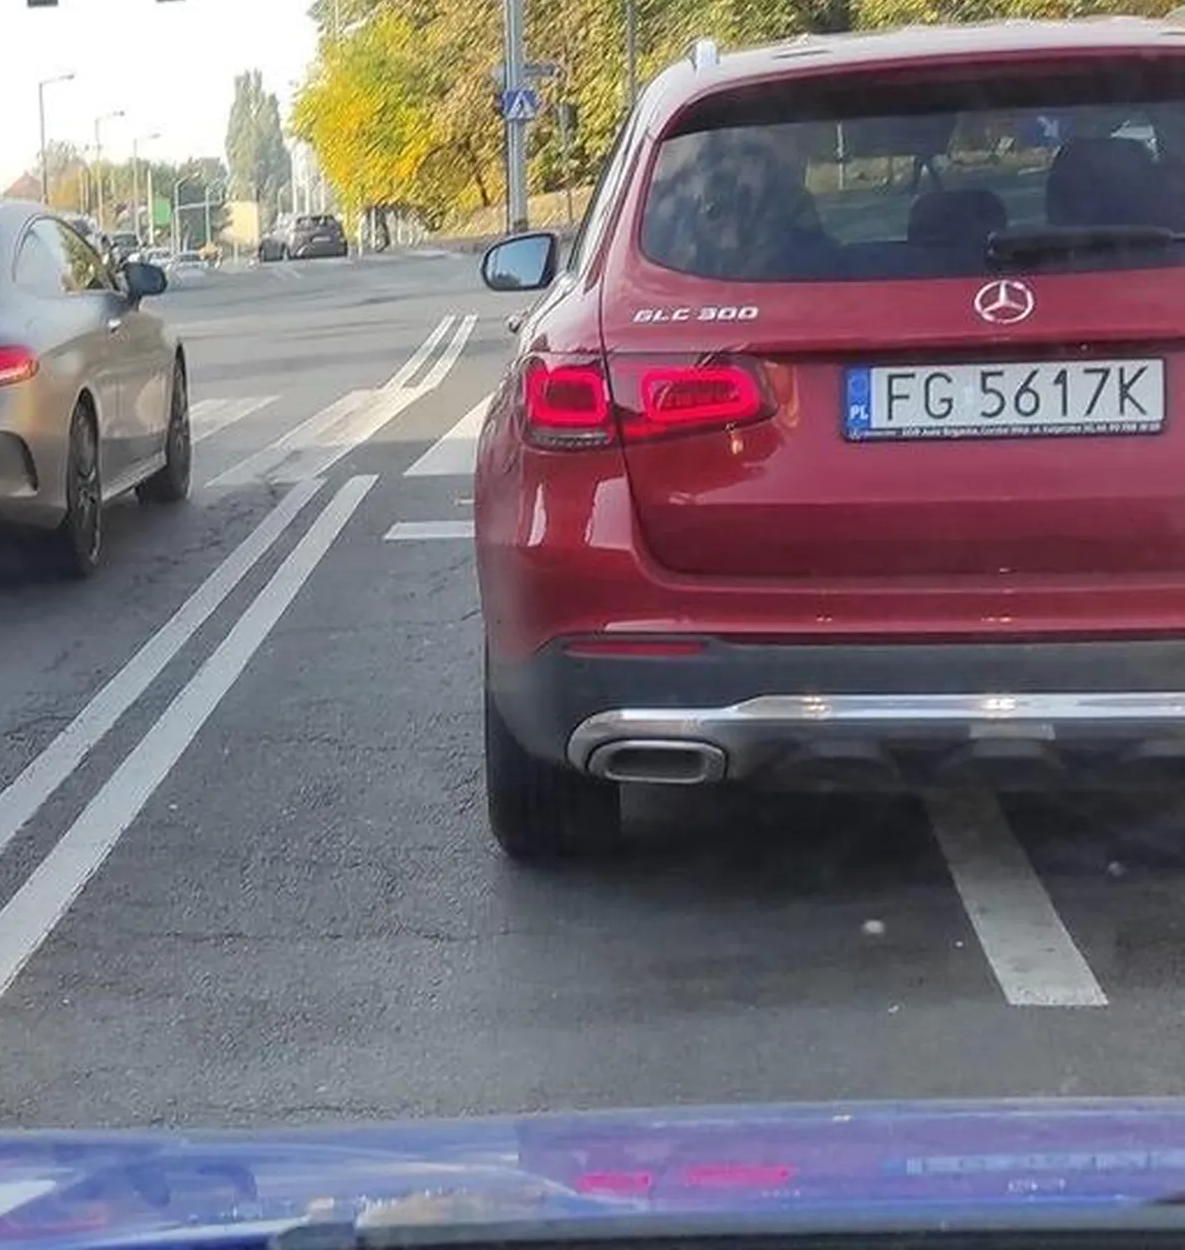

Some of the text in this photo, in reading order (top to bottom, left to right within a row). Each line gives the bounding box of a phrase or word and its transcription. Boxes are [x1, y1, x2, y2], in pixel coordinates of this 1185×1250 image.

[633, 306, 760, 323] GLC 300
[886, 365, 1149, 421] FG 5617K
[850, 404, 868, 419] PL
